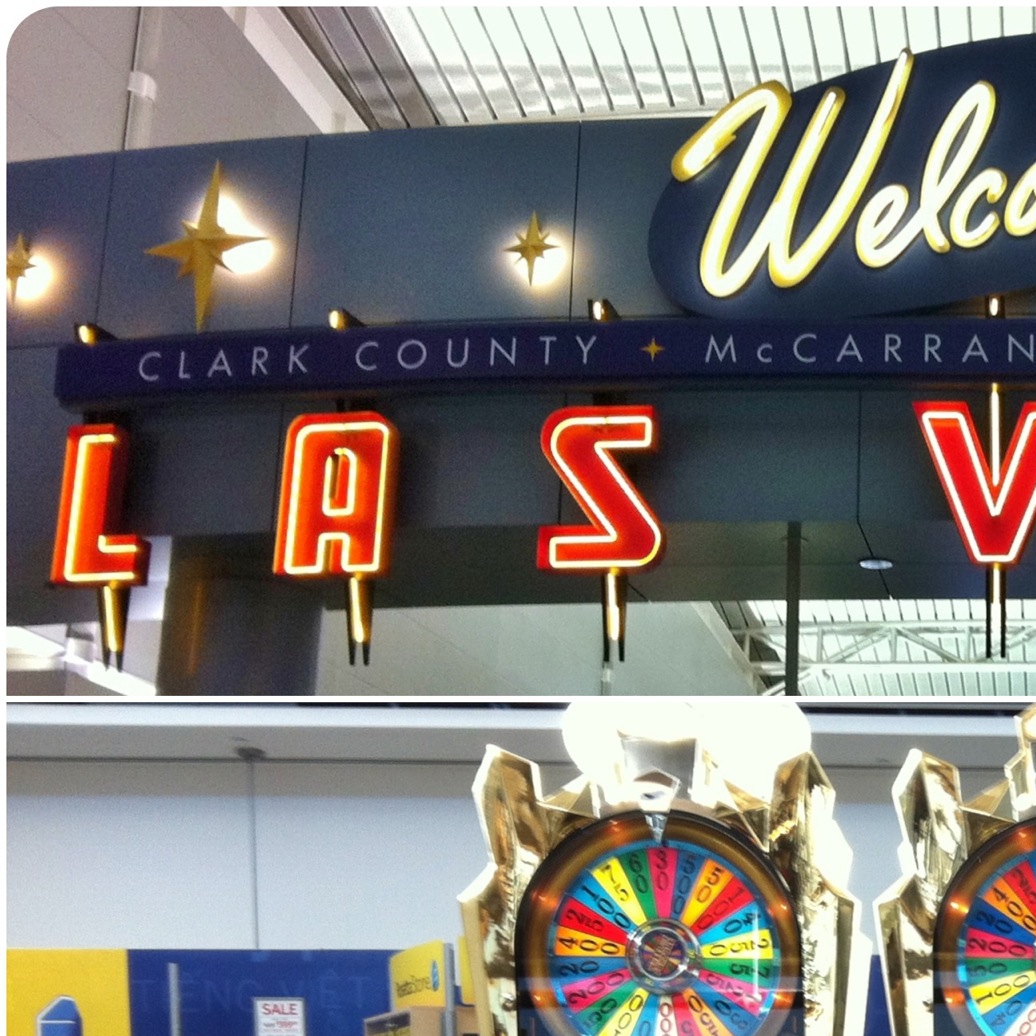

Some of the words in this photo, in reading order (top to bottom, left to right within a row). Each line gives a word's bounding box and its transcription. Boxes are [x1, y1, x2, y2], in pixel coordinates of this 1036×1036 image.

[138, 343, 312, 383] CLARK
[354, 335, 599, 372] COUNTY
[704, 333, 1036, 364] McCARRAN
[50, 404, 668, 586] LAS
[600, 863, 630, 902] 75
[656, 848, 669, 892] 30
[696, 866, 725, 904] 50
[581, 885, 632, 929] 100
[697, 886, 745, 931] 100
[723, 912, 762, 935] 40
[975, 911, 1014, 935] 20
[558, 936, 621, 956] 400
[709, 938, 771, 957] 250
[967, 937, 1028, 958] 200
[558, 960, 599, 977] 20
[730, 962, 771, 981] 75
[568, 971, 625, 1005] 200
[976, 974, 1031, 1004] 100
[261, 1002, 299, 1016] SALE
